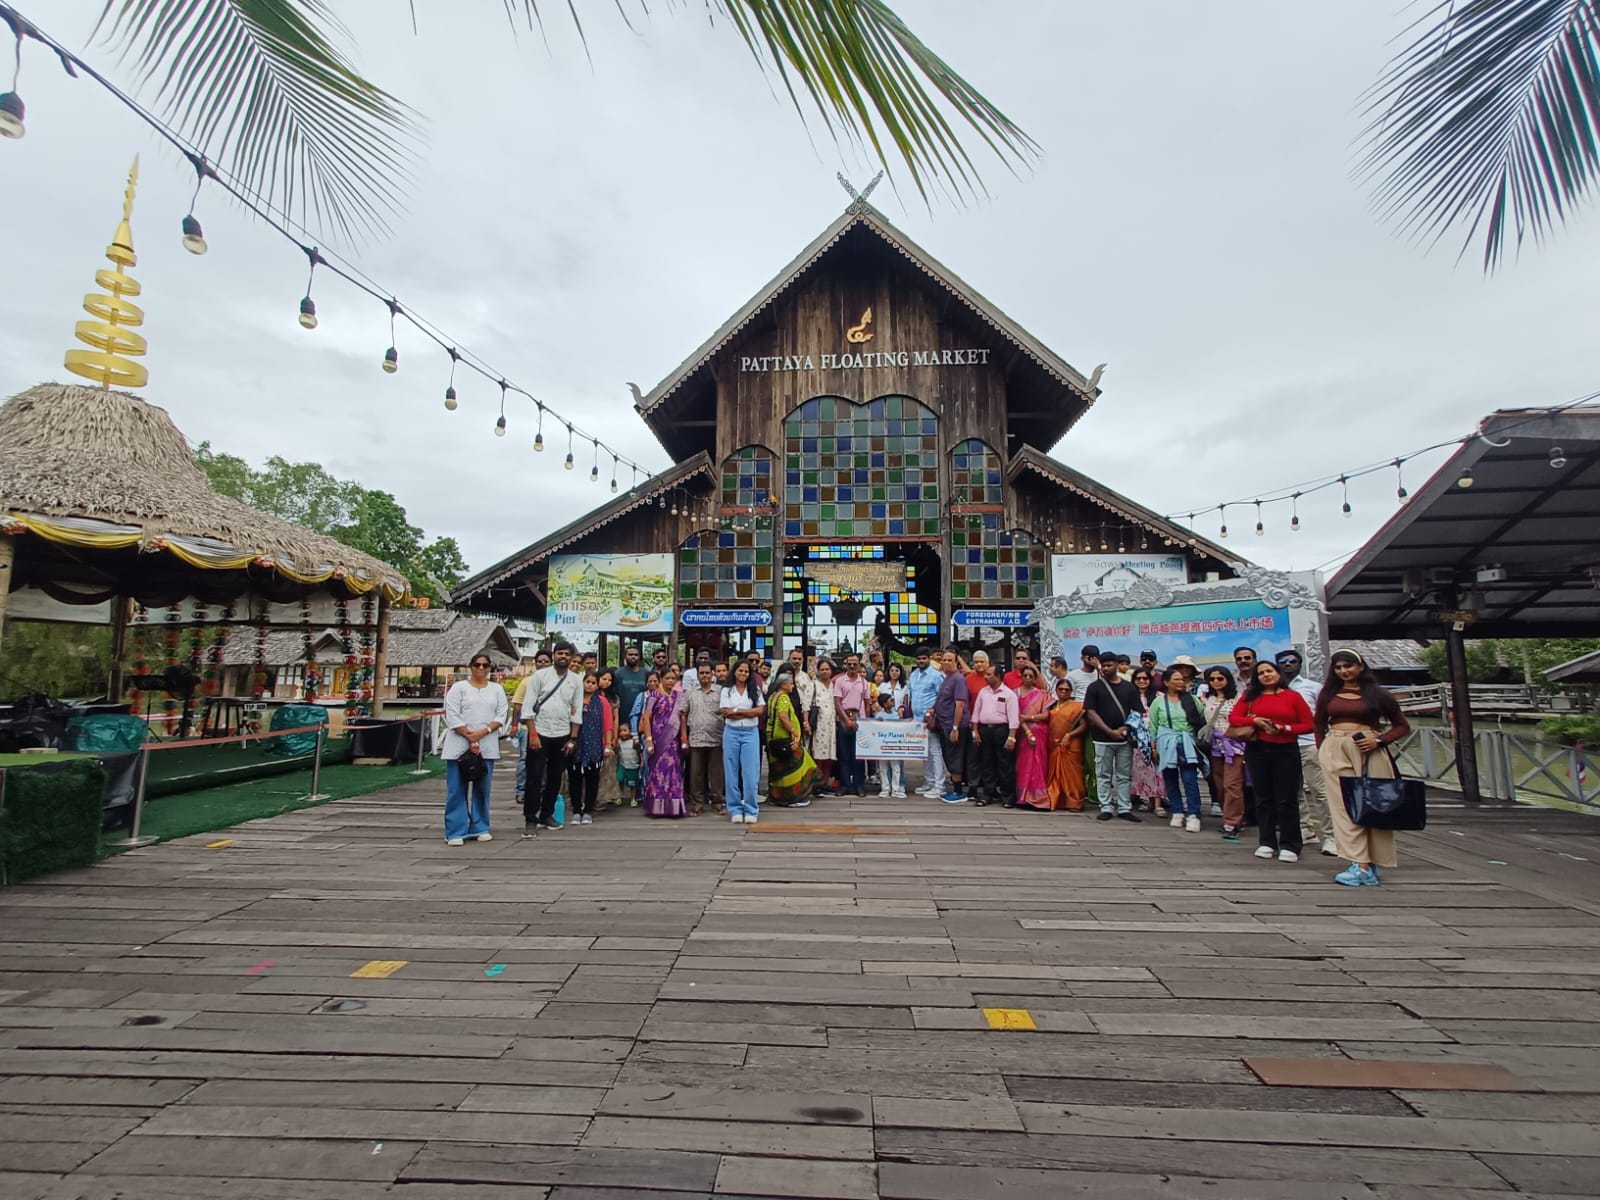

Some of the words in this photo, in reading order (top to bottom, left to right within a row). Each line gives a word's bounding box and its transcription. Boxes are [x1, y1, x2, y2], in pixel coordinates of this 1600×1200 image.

[740, 354, 815, 373] PATTAYA
[820, 351, 910, 370] FLOATING
[912, 348, 991, 367] MARKET
[1124, 559, 1156, 570] Meeting
[554, 613, 576, 625] Pier
